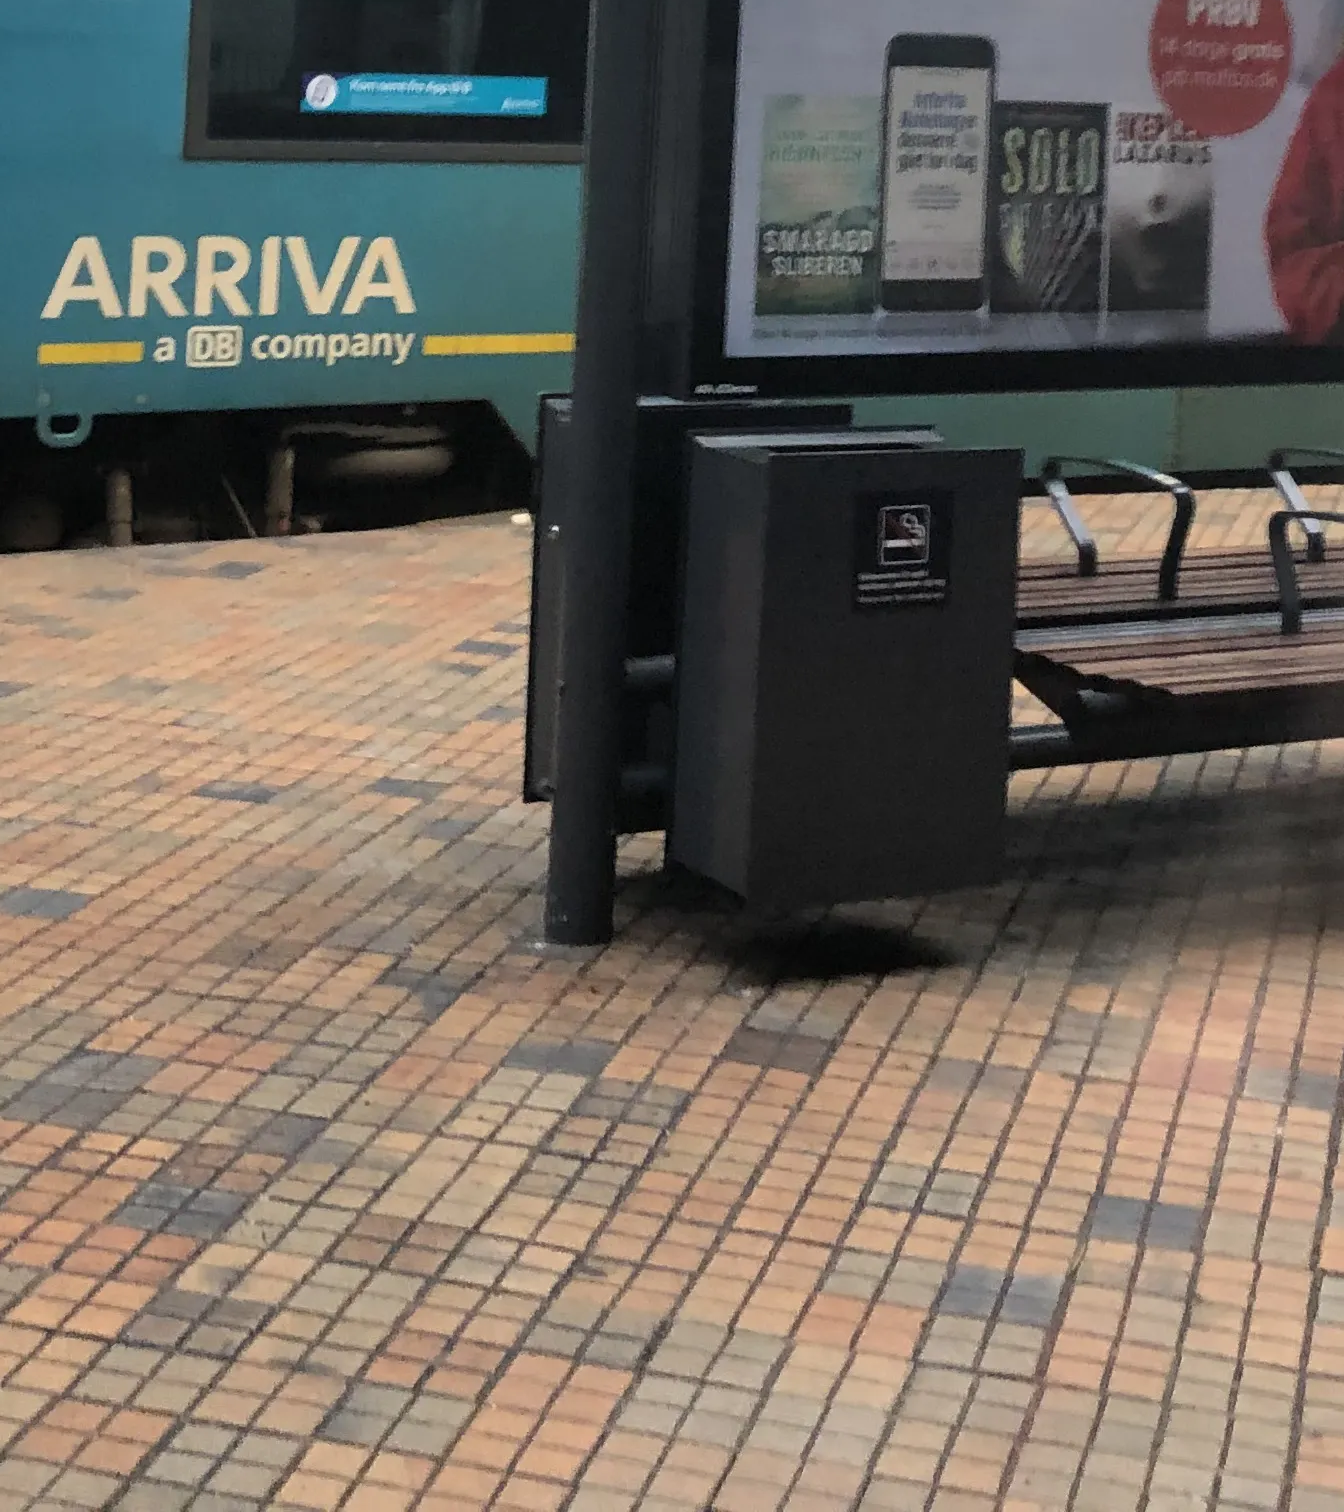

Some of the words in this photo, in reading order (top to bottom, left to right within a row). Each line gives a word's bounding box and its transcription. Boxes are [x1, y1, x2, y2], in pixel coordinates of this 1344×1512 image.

[1001, 127, 1101, 196] SOLO
[39, 235, 418, 320] ARRIVA
[152, 336, 177, 363] a
[189, 329, 238, 365] DB
[250, 332, 417, 367] company
